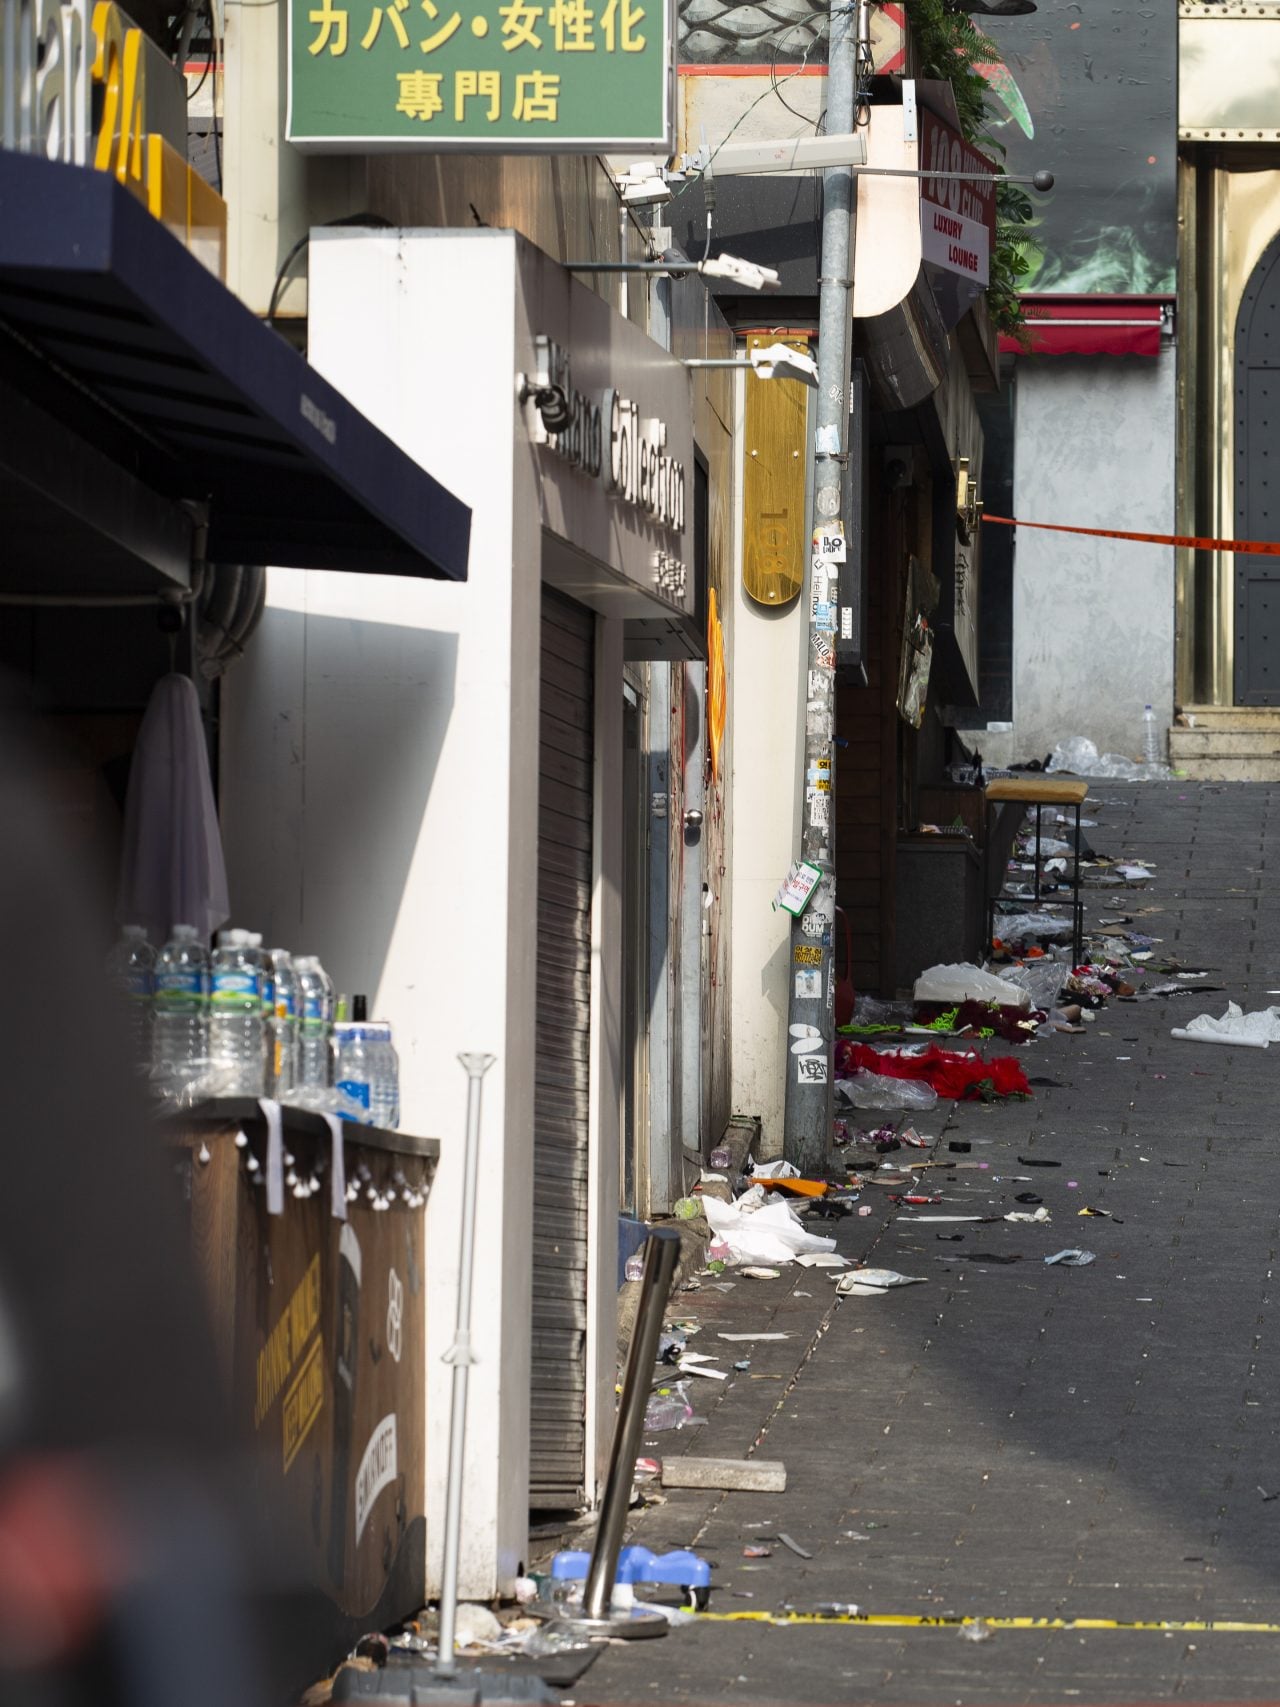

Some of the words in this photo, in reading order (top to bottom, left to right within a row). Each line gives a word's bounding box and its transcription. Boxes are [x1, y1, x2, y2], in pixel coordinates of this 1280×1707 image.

[928, 125, 963, 214] 108
[933, 212, 964, 241] LUXURY
[948, 244, 979, 273] LOUNGE
[811, 575, 823, 617] Helinox
[811, 632, 830, 657] MALO
